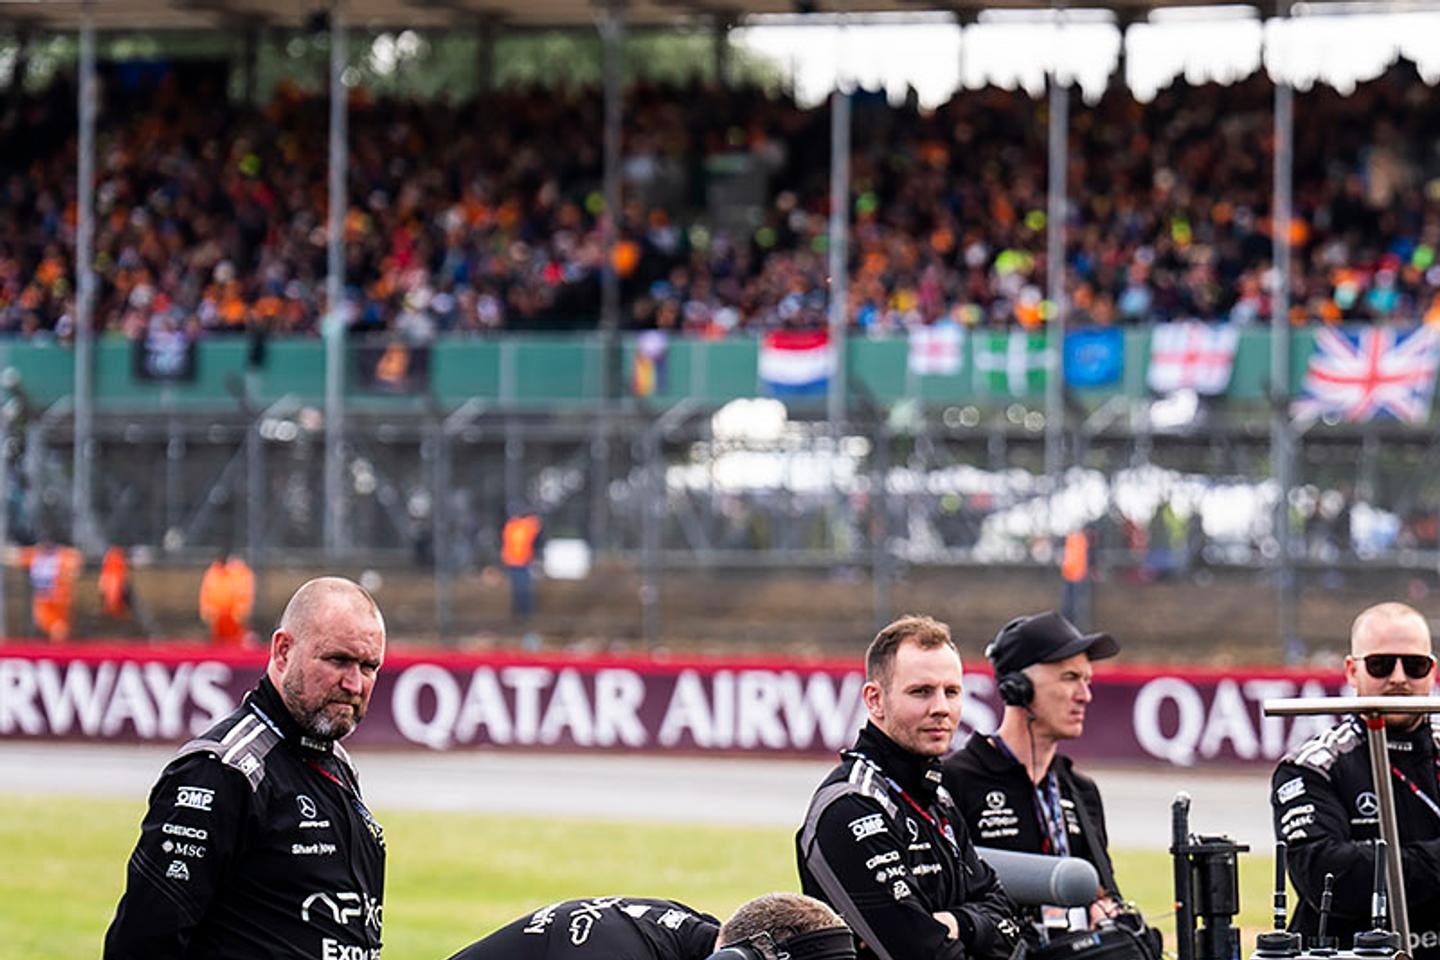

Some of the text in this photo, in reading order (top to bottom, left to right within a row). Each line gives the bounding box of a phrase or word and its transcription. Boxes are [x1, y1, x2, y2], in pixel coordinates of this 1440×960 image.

[391, 662, 1000, 752] QATAR AIRWS
[175, 789, 214, 809] OMP
[162, 822, 208, 840] GEICO
[174, 841, 207, 858] MSC
